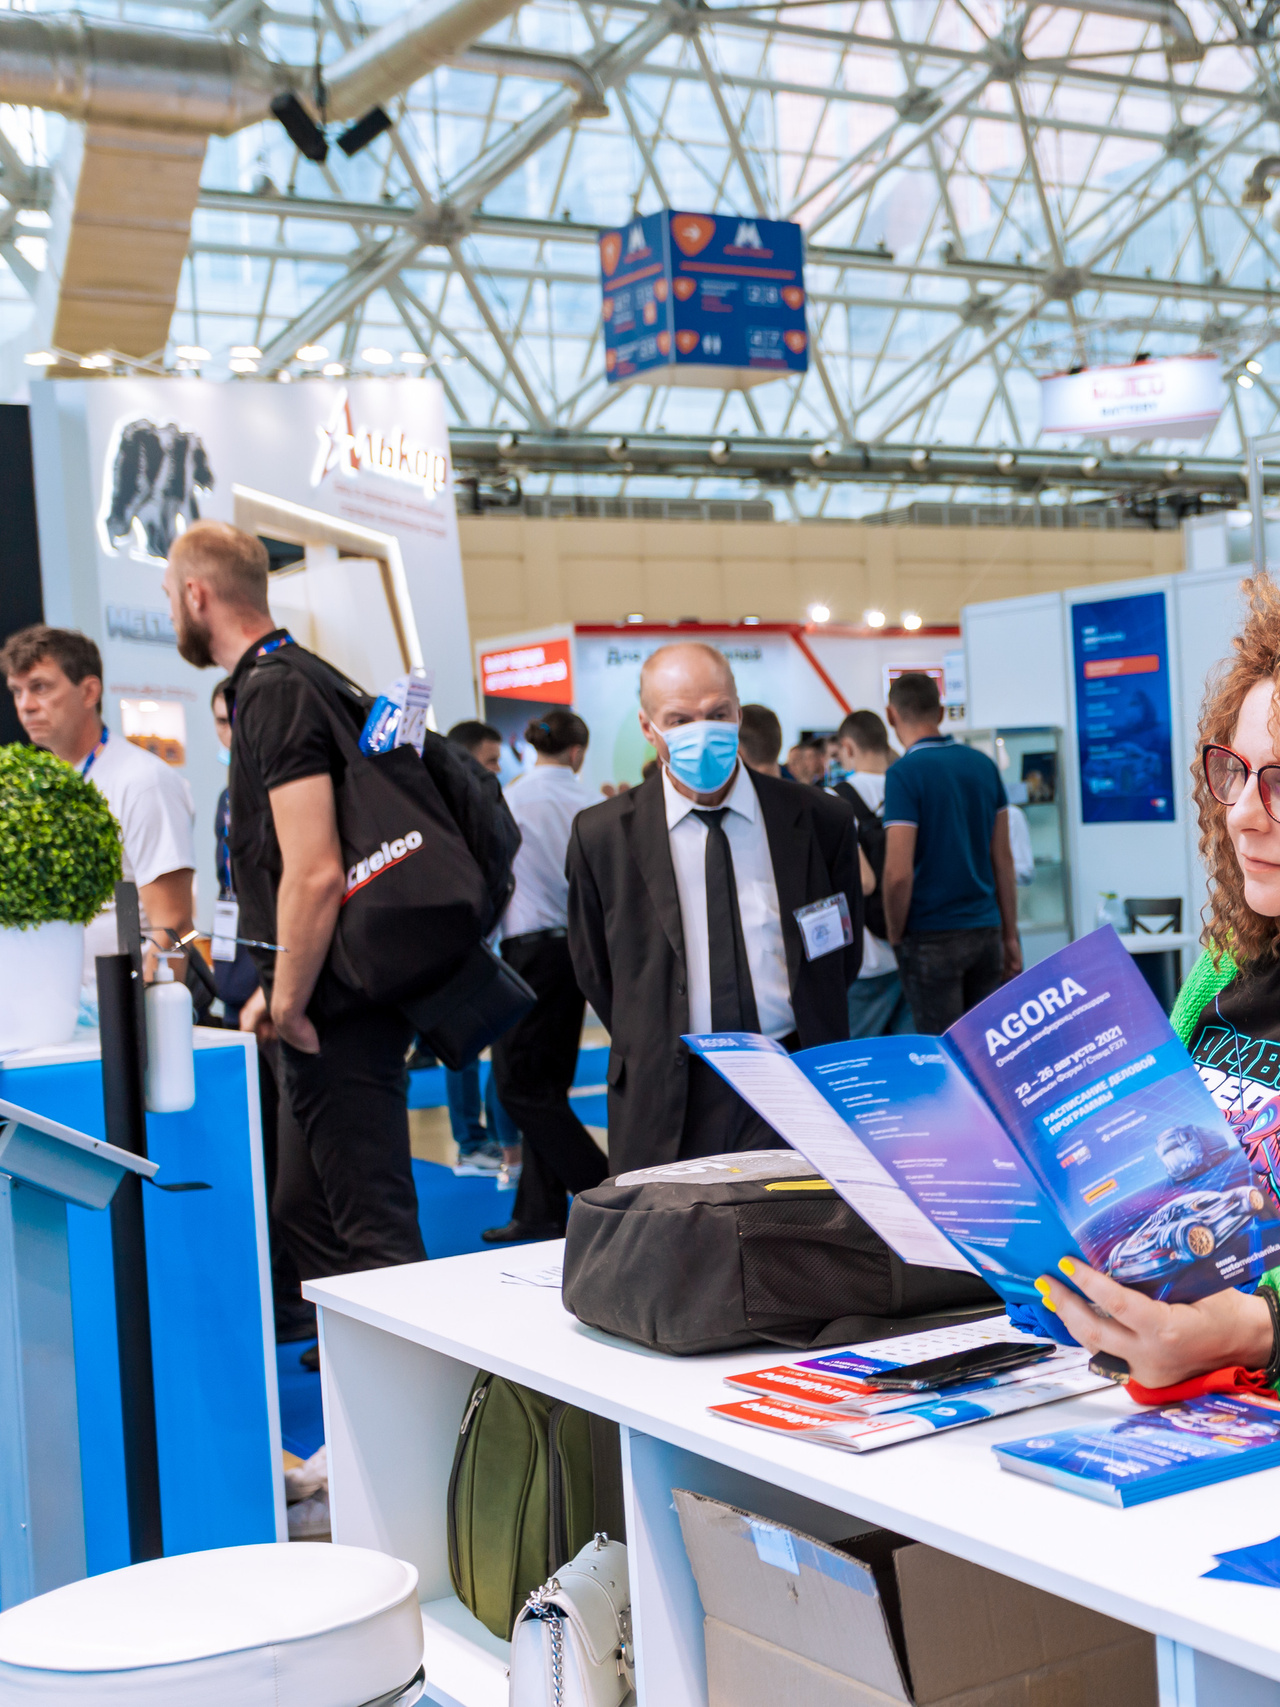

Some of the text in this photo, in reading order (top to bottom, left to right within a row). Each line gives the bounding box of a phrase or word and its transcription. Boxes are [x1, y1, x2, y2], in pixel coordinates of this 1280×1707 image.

[985, 977, 1088, 1057] AGORA
[1015, 1082, 1032, 1099] 23
[1037, 1066, 1055, 1083] 26
[1053, 1042, 1097, 1073] августа
[1094, 1025, 1123, 1048] 2021
[1042, 1079, 1109, 1126] РАСПИСАНИЕ
[1107, 1054, 1157, 1087] ДЕЛОВОЙ
[1049, 1091, 1114, 1135] ПРОГРАММЫ
